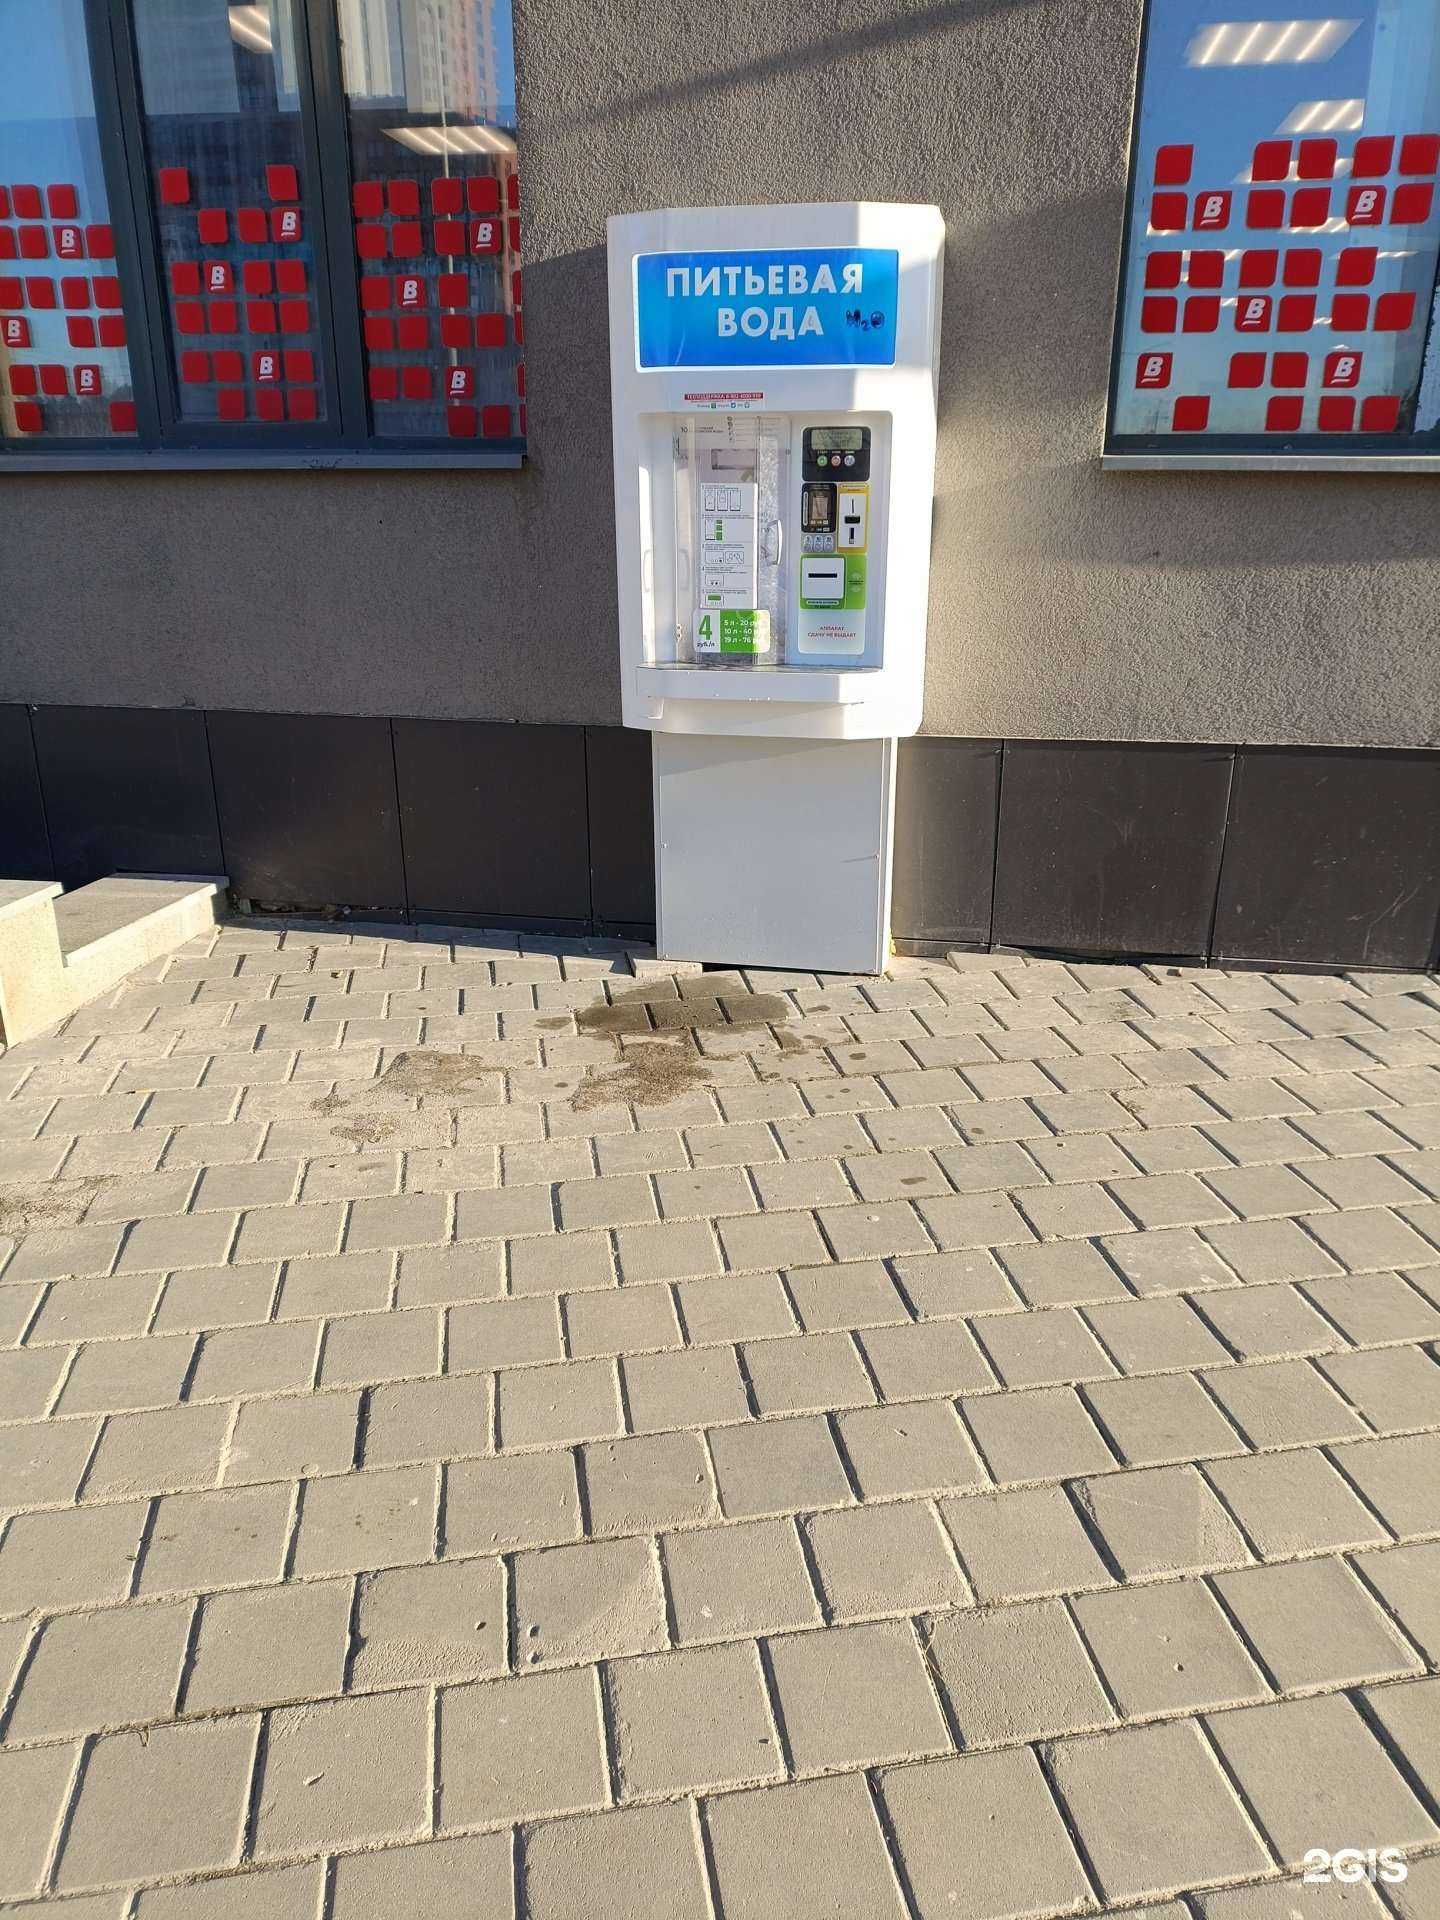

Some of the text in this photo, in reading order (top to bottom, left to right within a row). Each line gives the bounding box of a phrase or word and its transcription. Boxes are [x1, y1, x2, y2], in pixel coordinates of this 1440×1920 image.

[666, 263, 863, 297] ПИТЬЕВАЯ
[717, 306, 824, 341] ВОДА
[698, 614, 713, 641] 4
